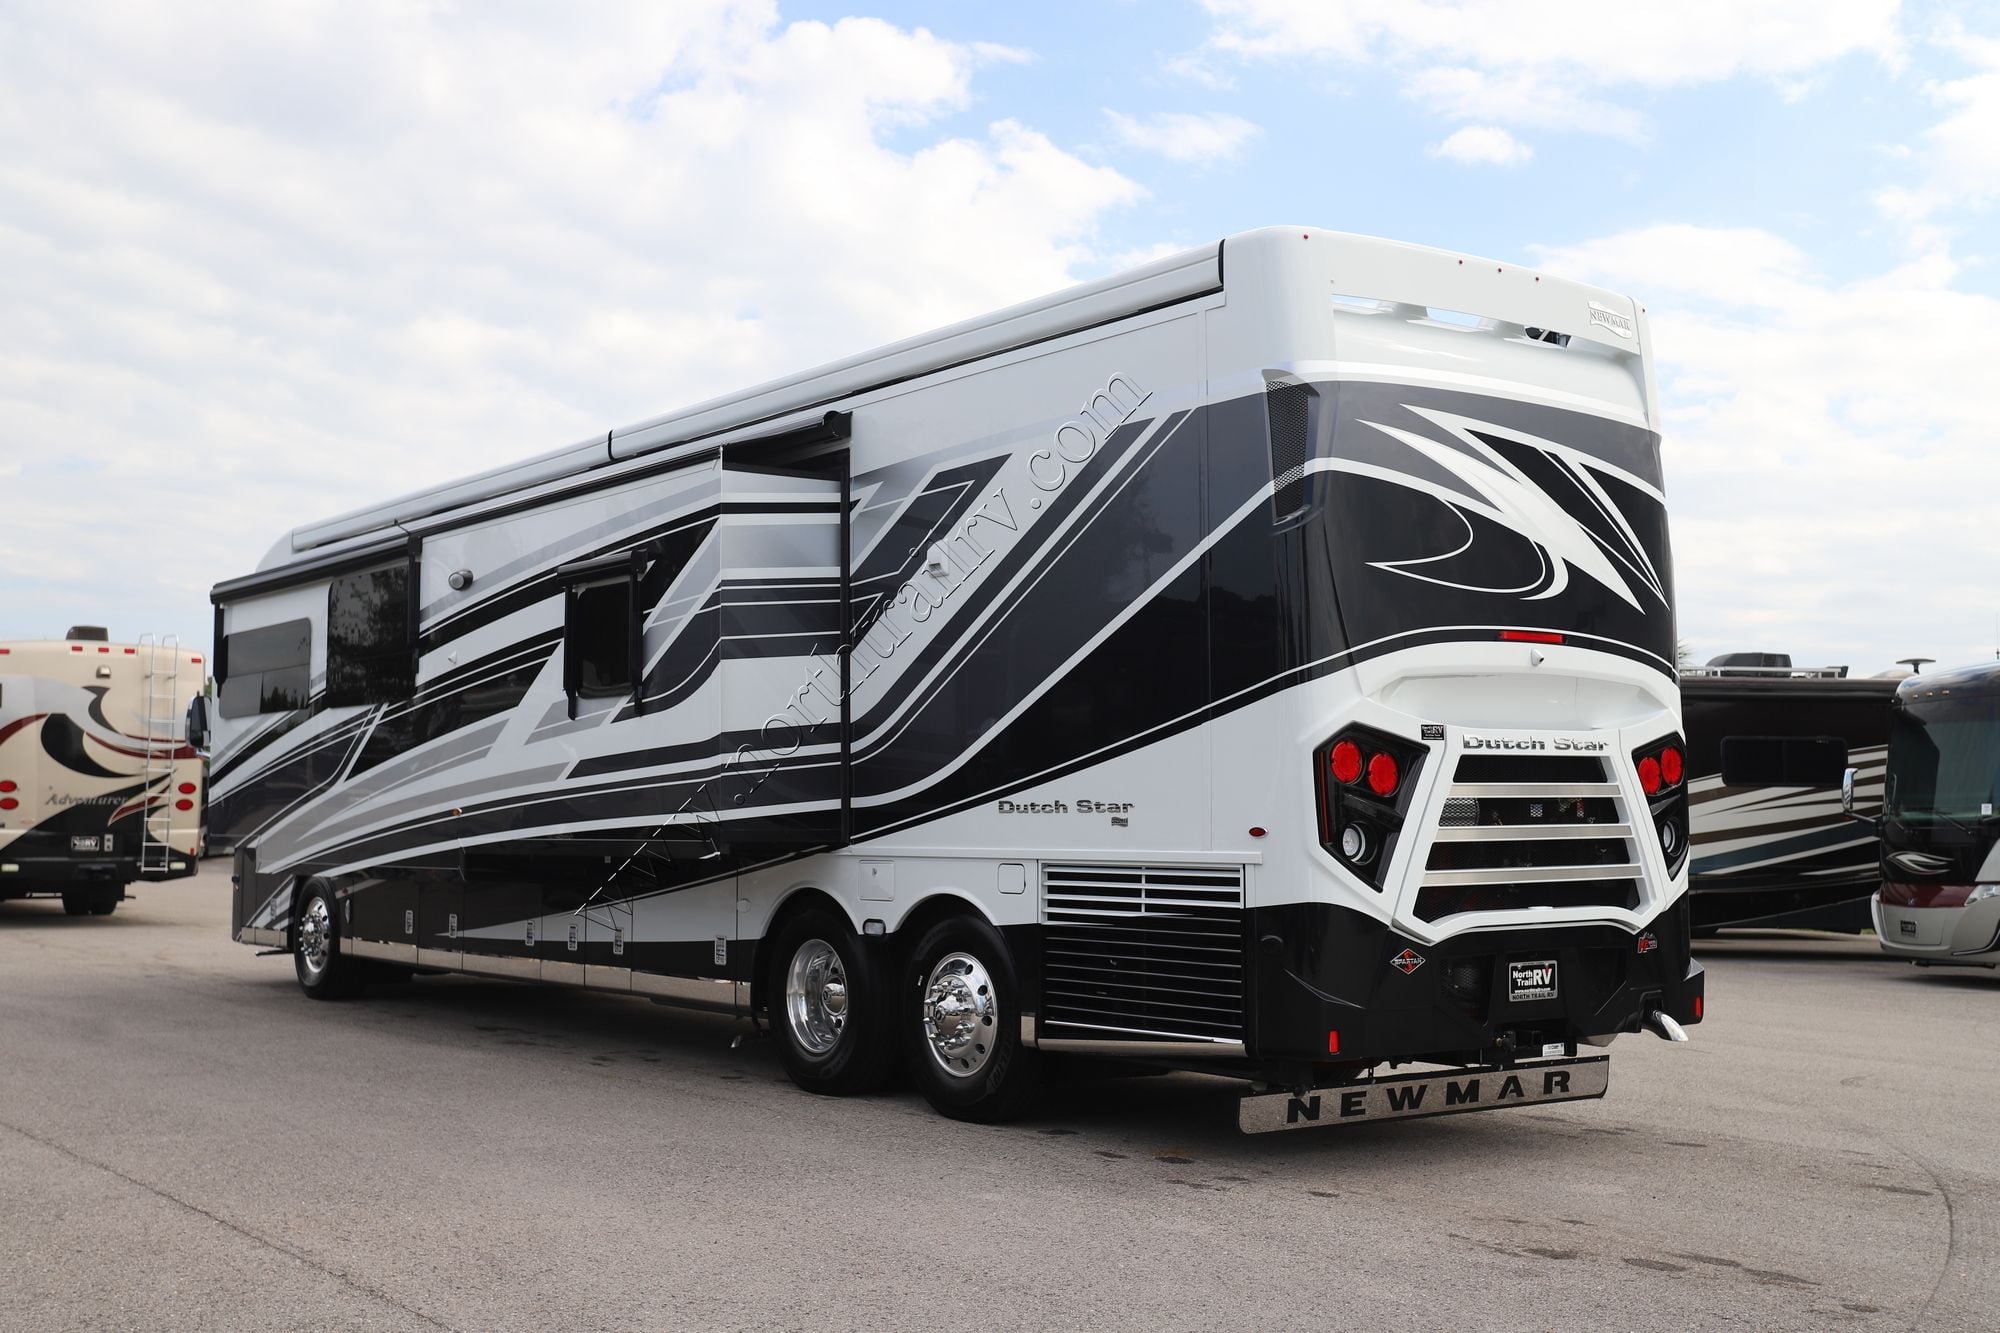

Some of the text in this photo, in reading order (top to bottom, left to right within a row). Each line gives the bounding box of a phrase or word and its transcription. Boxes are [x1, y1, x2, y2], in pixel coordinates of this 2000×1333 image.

[1589, 309, 1632, 331] NEWMAR
[1463, 734, 1609, 751] Dutch Star
[46, 794, 128, 806] Adventurer
[999, 799, 1135, 814] Dutch Star
[1513, 968, 1552, 986] North RV
[1517, 977, 1533, 987] Trail
[1287, 1070, 1570, 1123] NEWMAR
